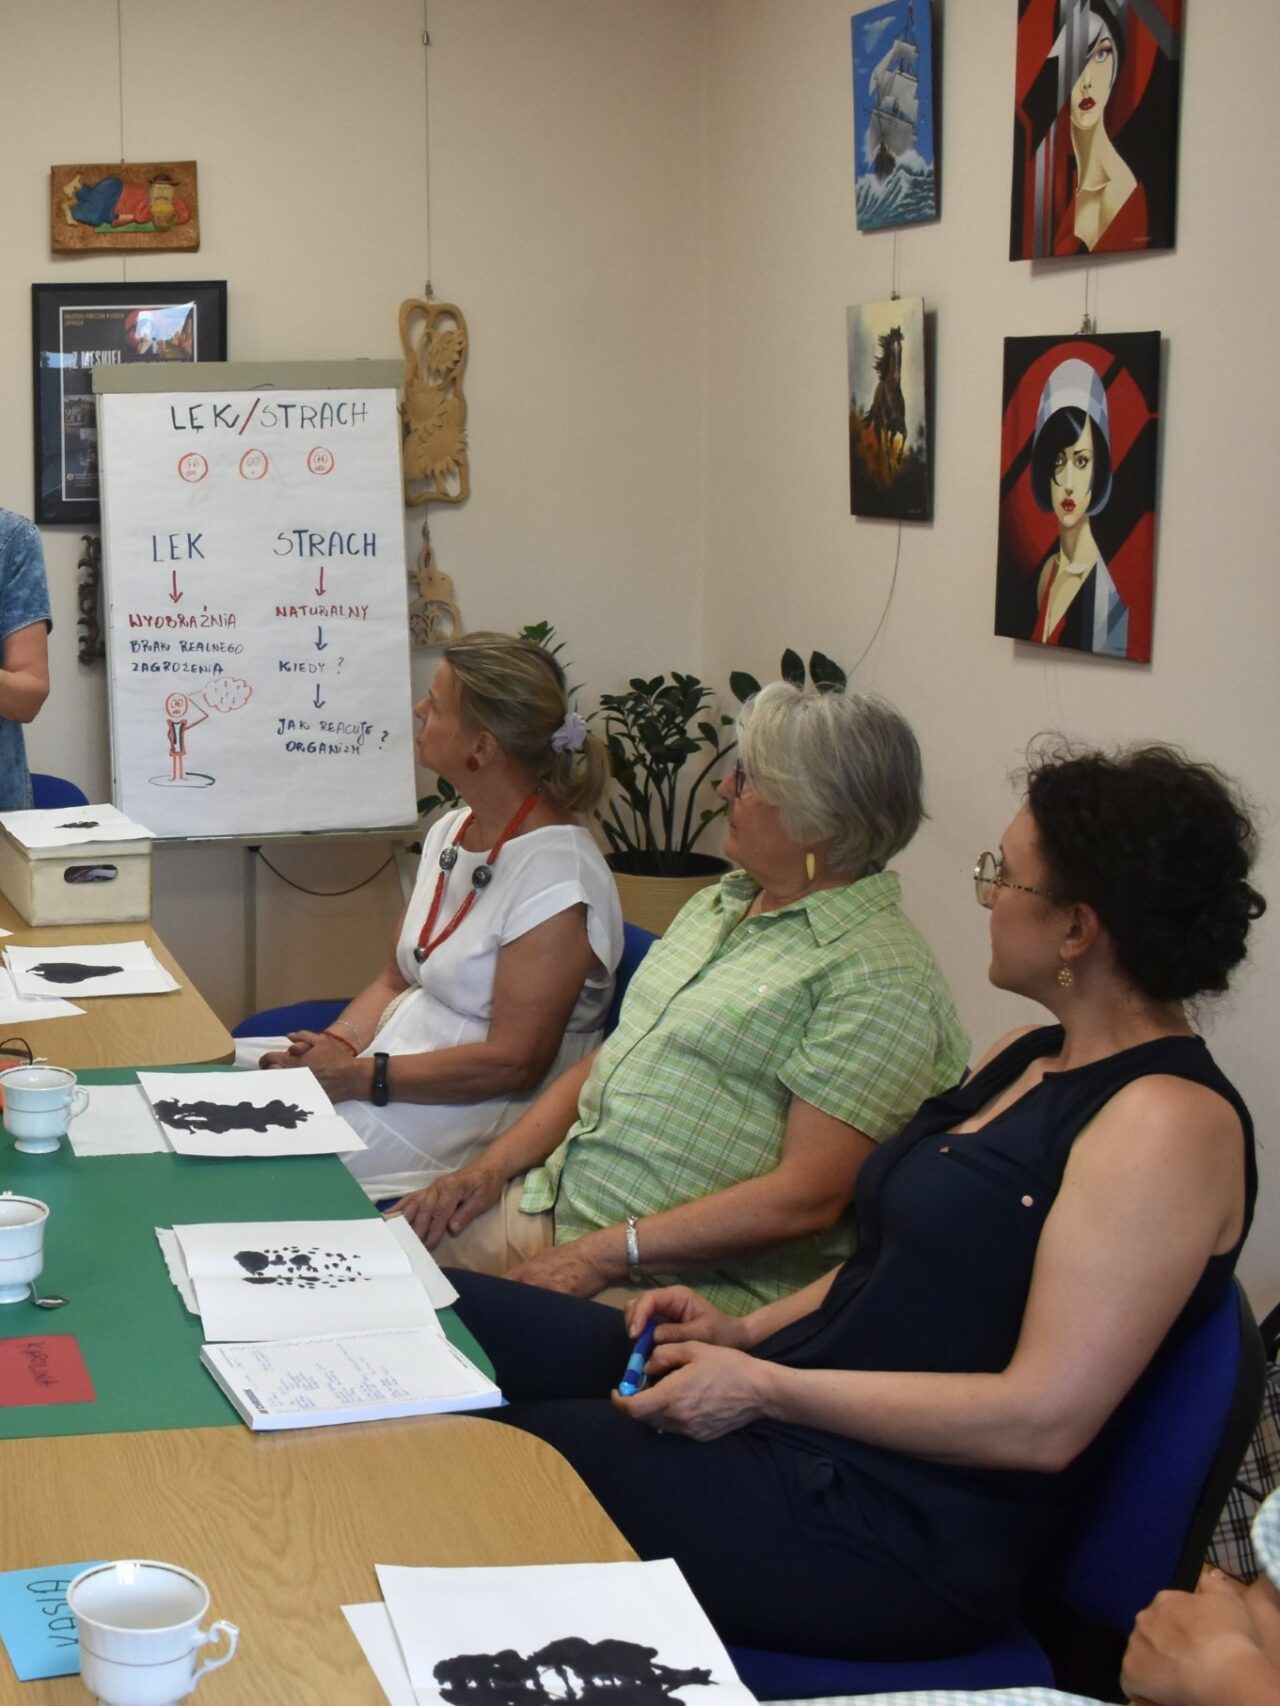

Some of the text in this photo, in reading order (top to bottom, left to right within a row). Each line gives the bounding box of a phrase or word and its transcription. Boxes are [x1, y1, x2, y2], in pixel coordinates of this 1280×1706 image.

[273, 529, 376, 556] STRACH
[275, 604, 369, 621] NATURALNY
[179, 640, 244, 655] REALNEGO
[278, 660, 326, 674] KIEDY
[277, 718, 310, 736] JAK
